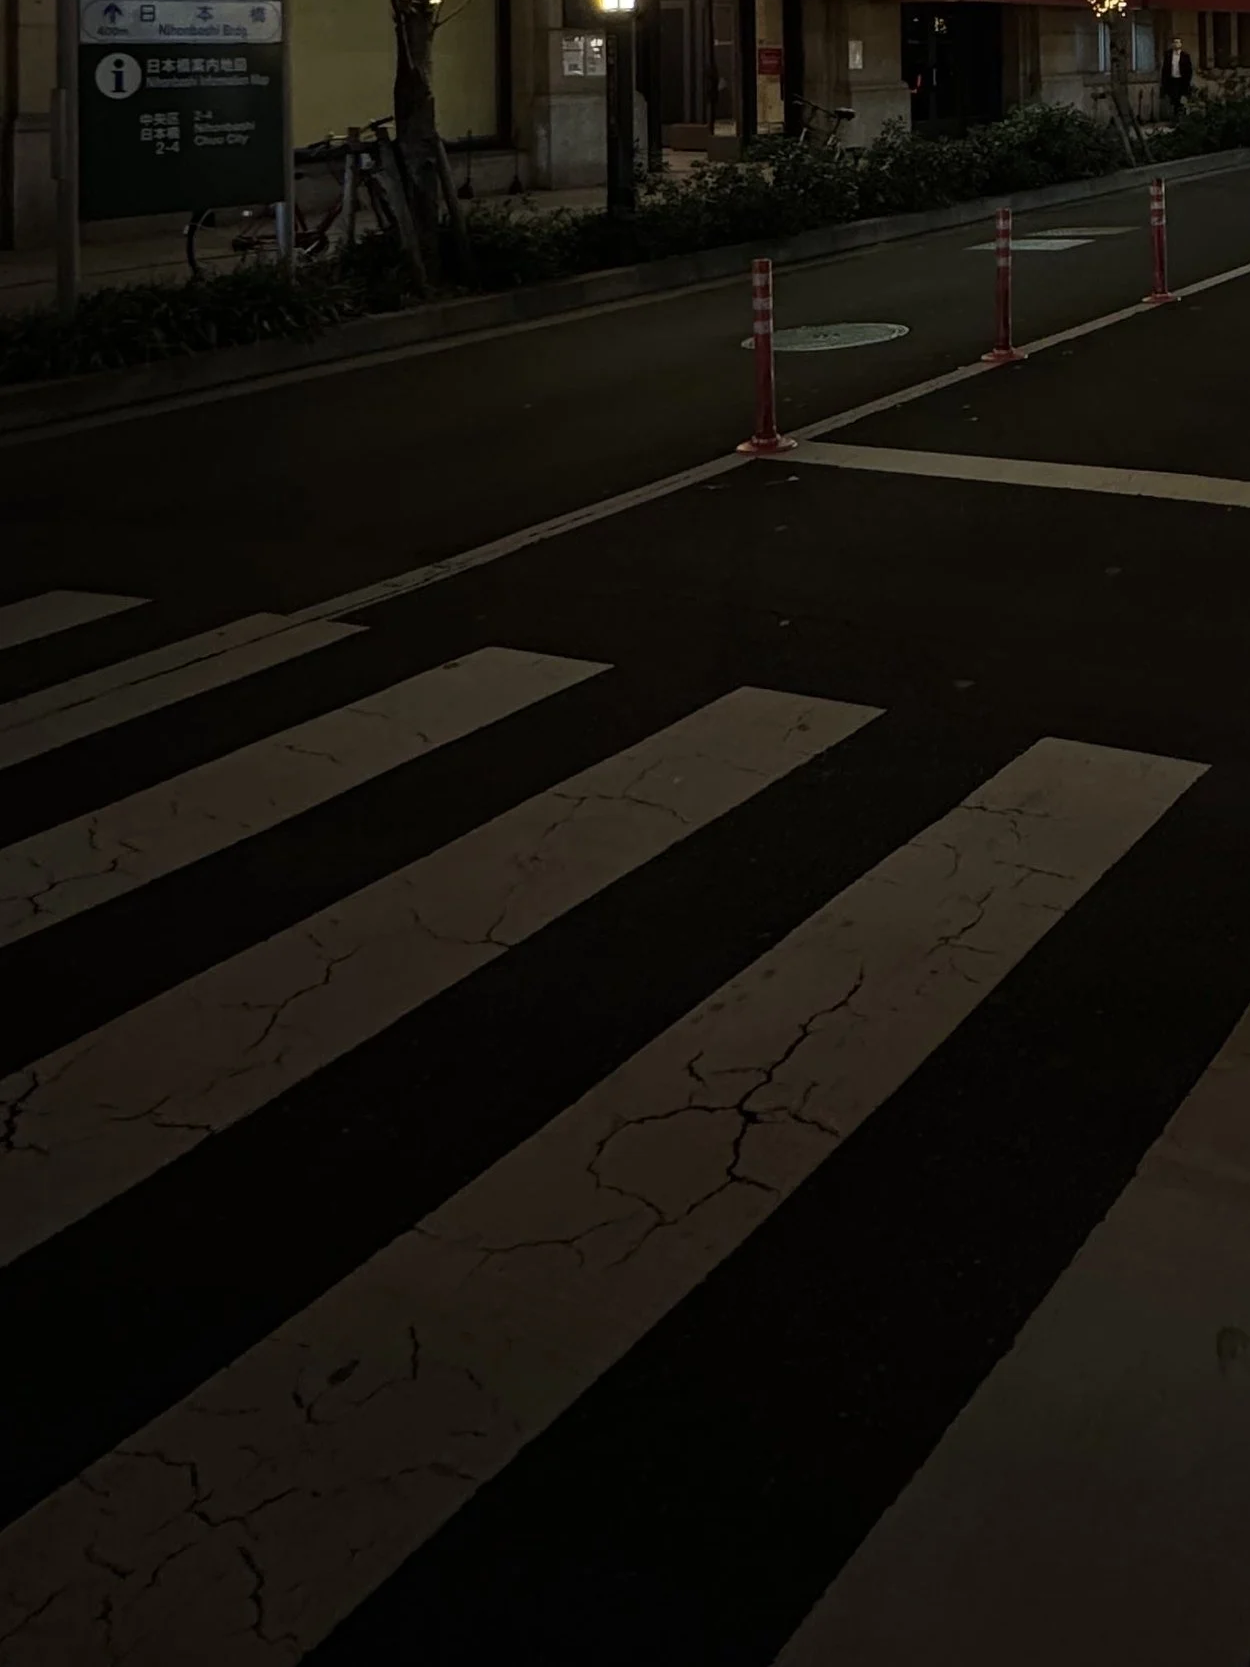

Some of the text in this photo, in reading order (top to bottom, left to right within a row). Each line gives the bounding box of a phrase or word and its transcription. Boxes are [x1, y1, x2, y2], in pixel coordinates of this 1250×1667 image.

[139, 125, 181, 141] 日本橋
[155, 140, 181, 155] 2-4
